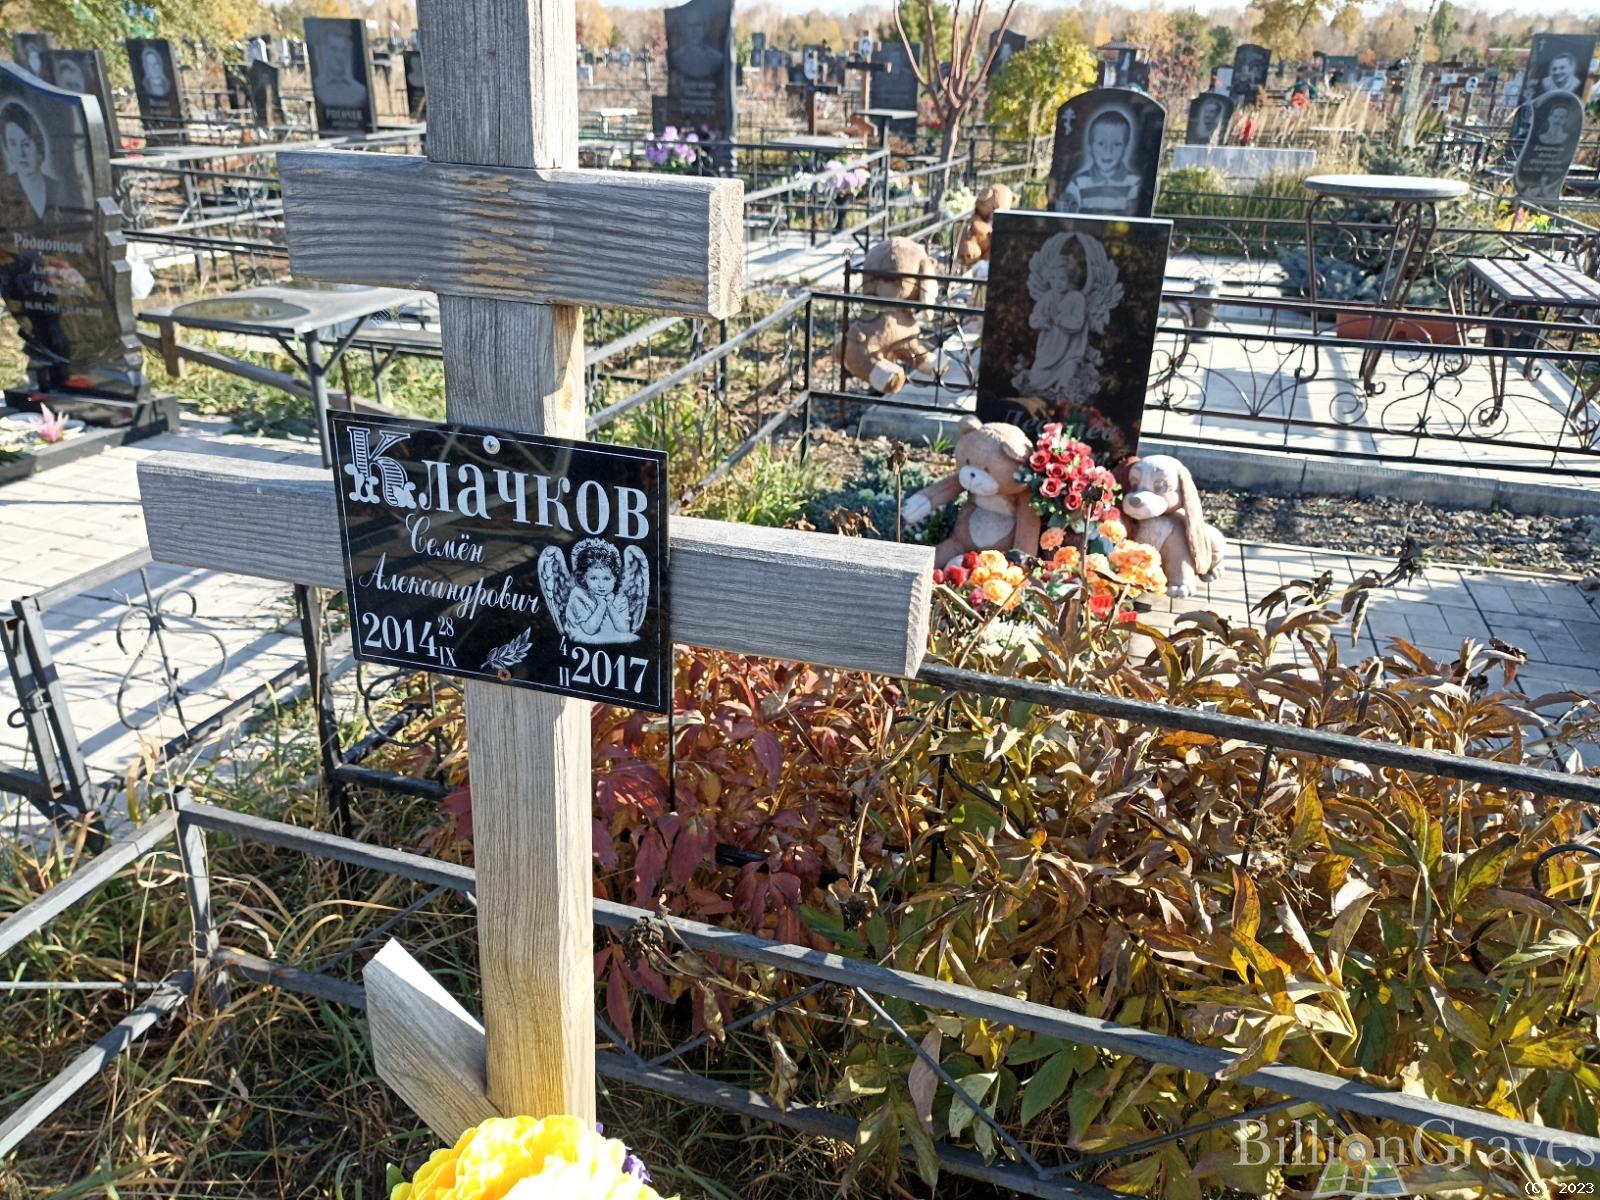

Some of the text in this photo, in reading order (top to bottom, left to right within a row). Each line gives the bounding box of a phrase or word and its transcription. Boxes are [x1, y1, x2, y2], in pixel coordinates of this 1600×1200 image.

[344, 426, 650, 541] Клачков
[405, 513, 484, 564] Семён
[358, 551, 540, 620] Александрович
[362, 612, 440, 658] 2014
[437, 615, 455, 637] 28
[559, 635, 568, 656] 4
[439, 646, 457, 668] IX
[571, 646, 649, 694] 2017
